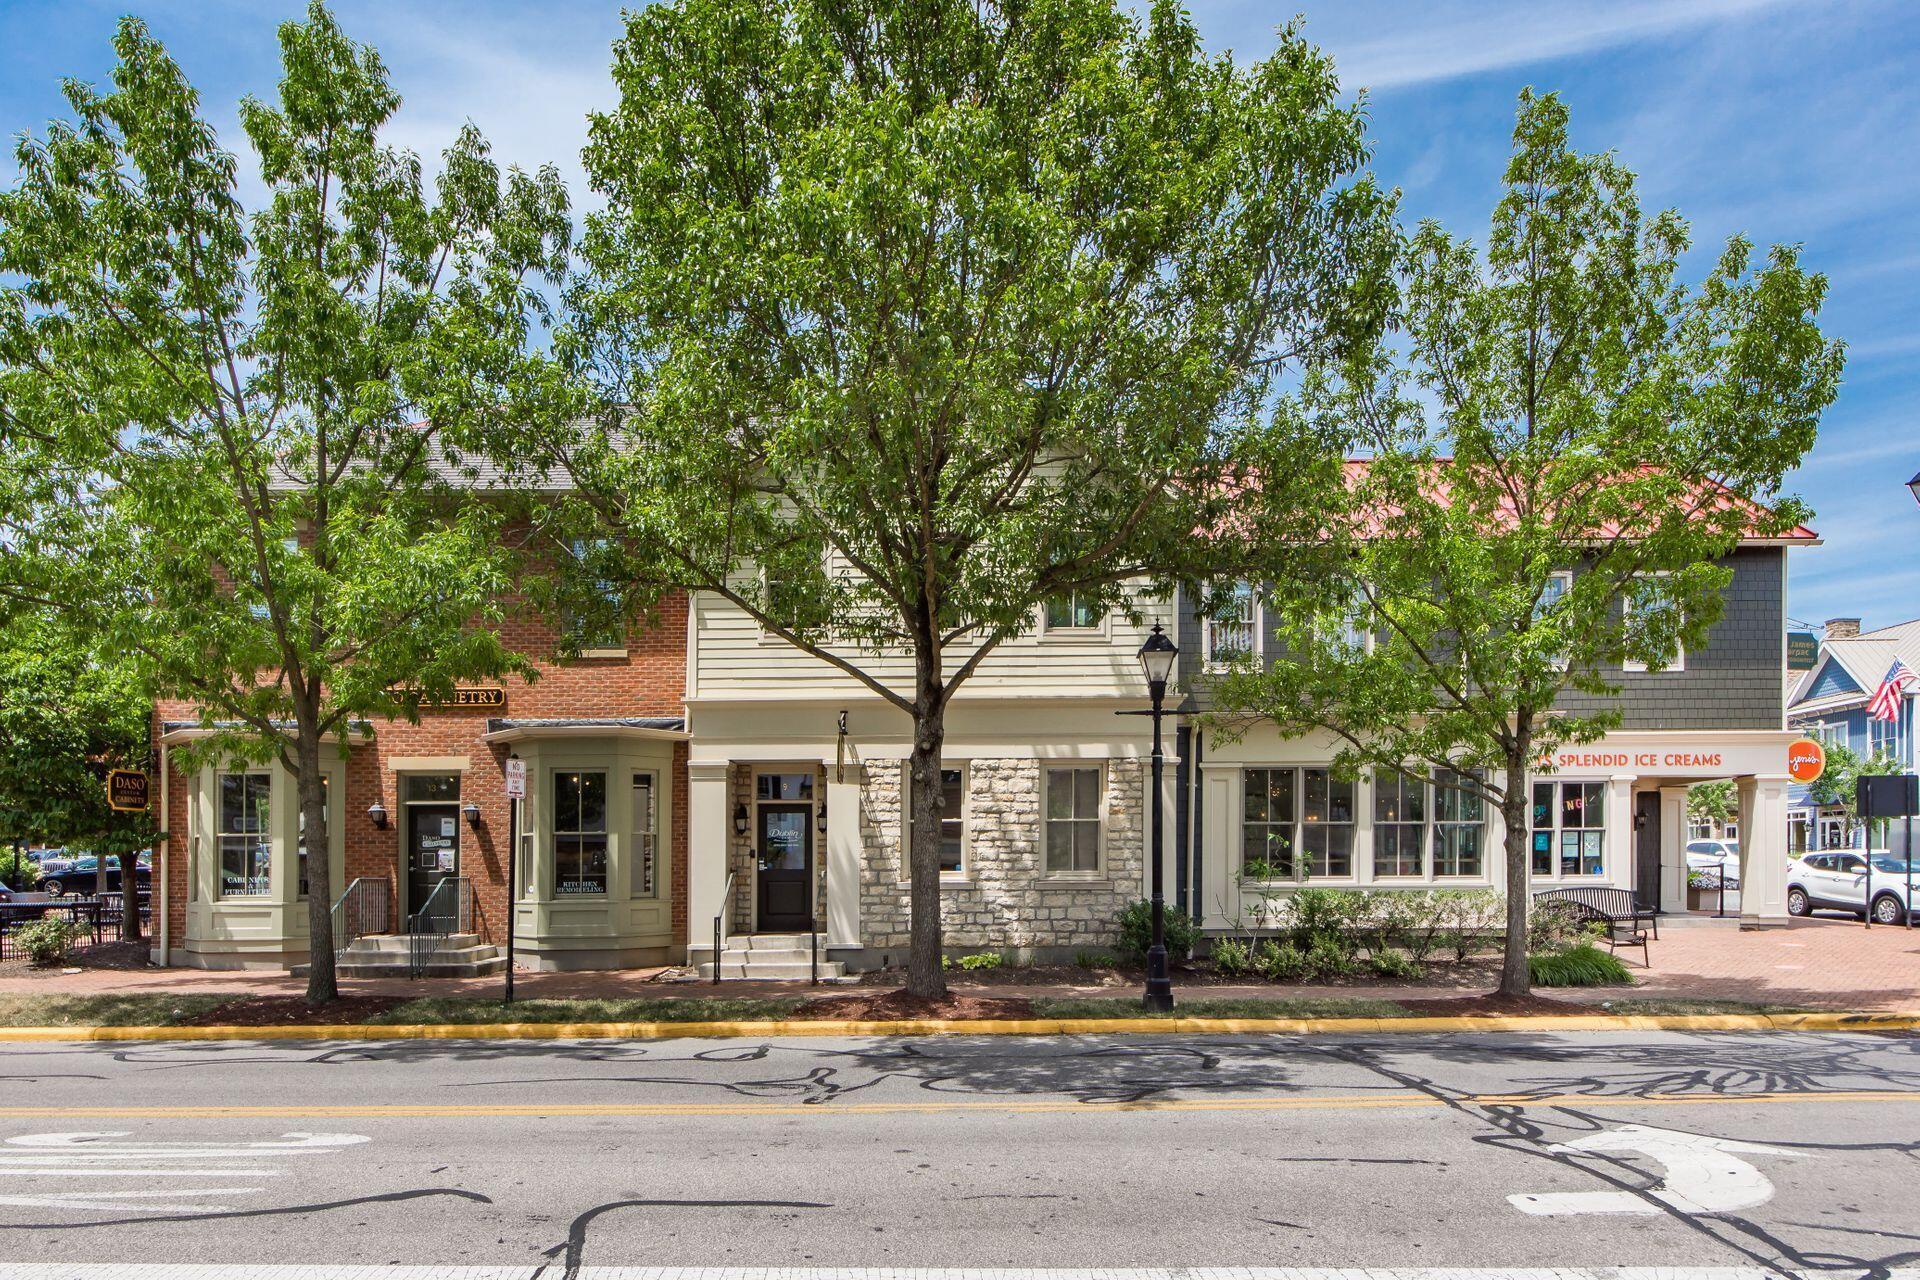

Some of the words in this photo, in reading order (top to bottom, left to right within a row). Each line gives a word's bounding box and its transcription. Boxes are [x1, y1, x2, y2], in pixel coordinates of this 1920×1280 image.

[1559, 754, 1628, 767] SPLENDID
[1635, 754, 1657, 766] ICE
[1664, 754, 1721, 767] CREAMS
[512, 761, 521, 771] NO
[115, 776, 145, 790] DASO
[428, 784, 437, 792] 13
[770, 828, 799, 838] Dublin
